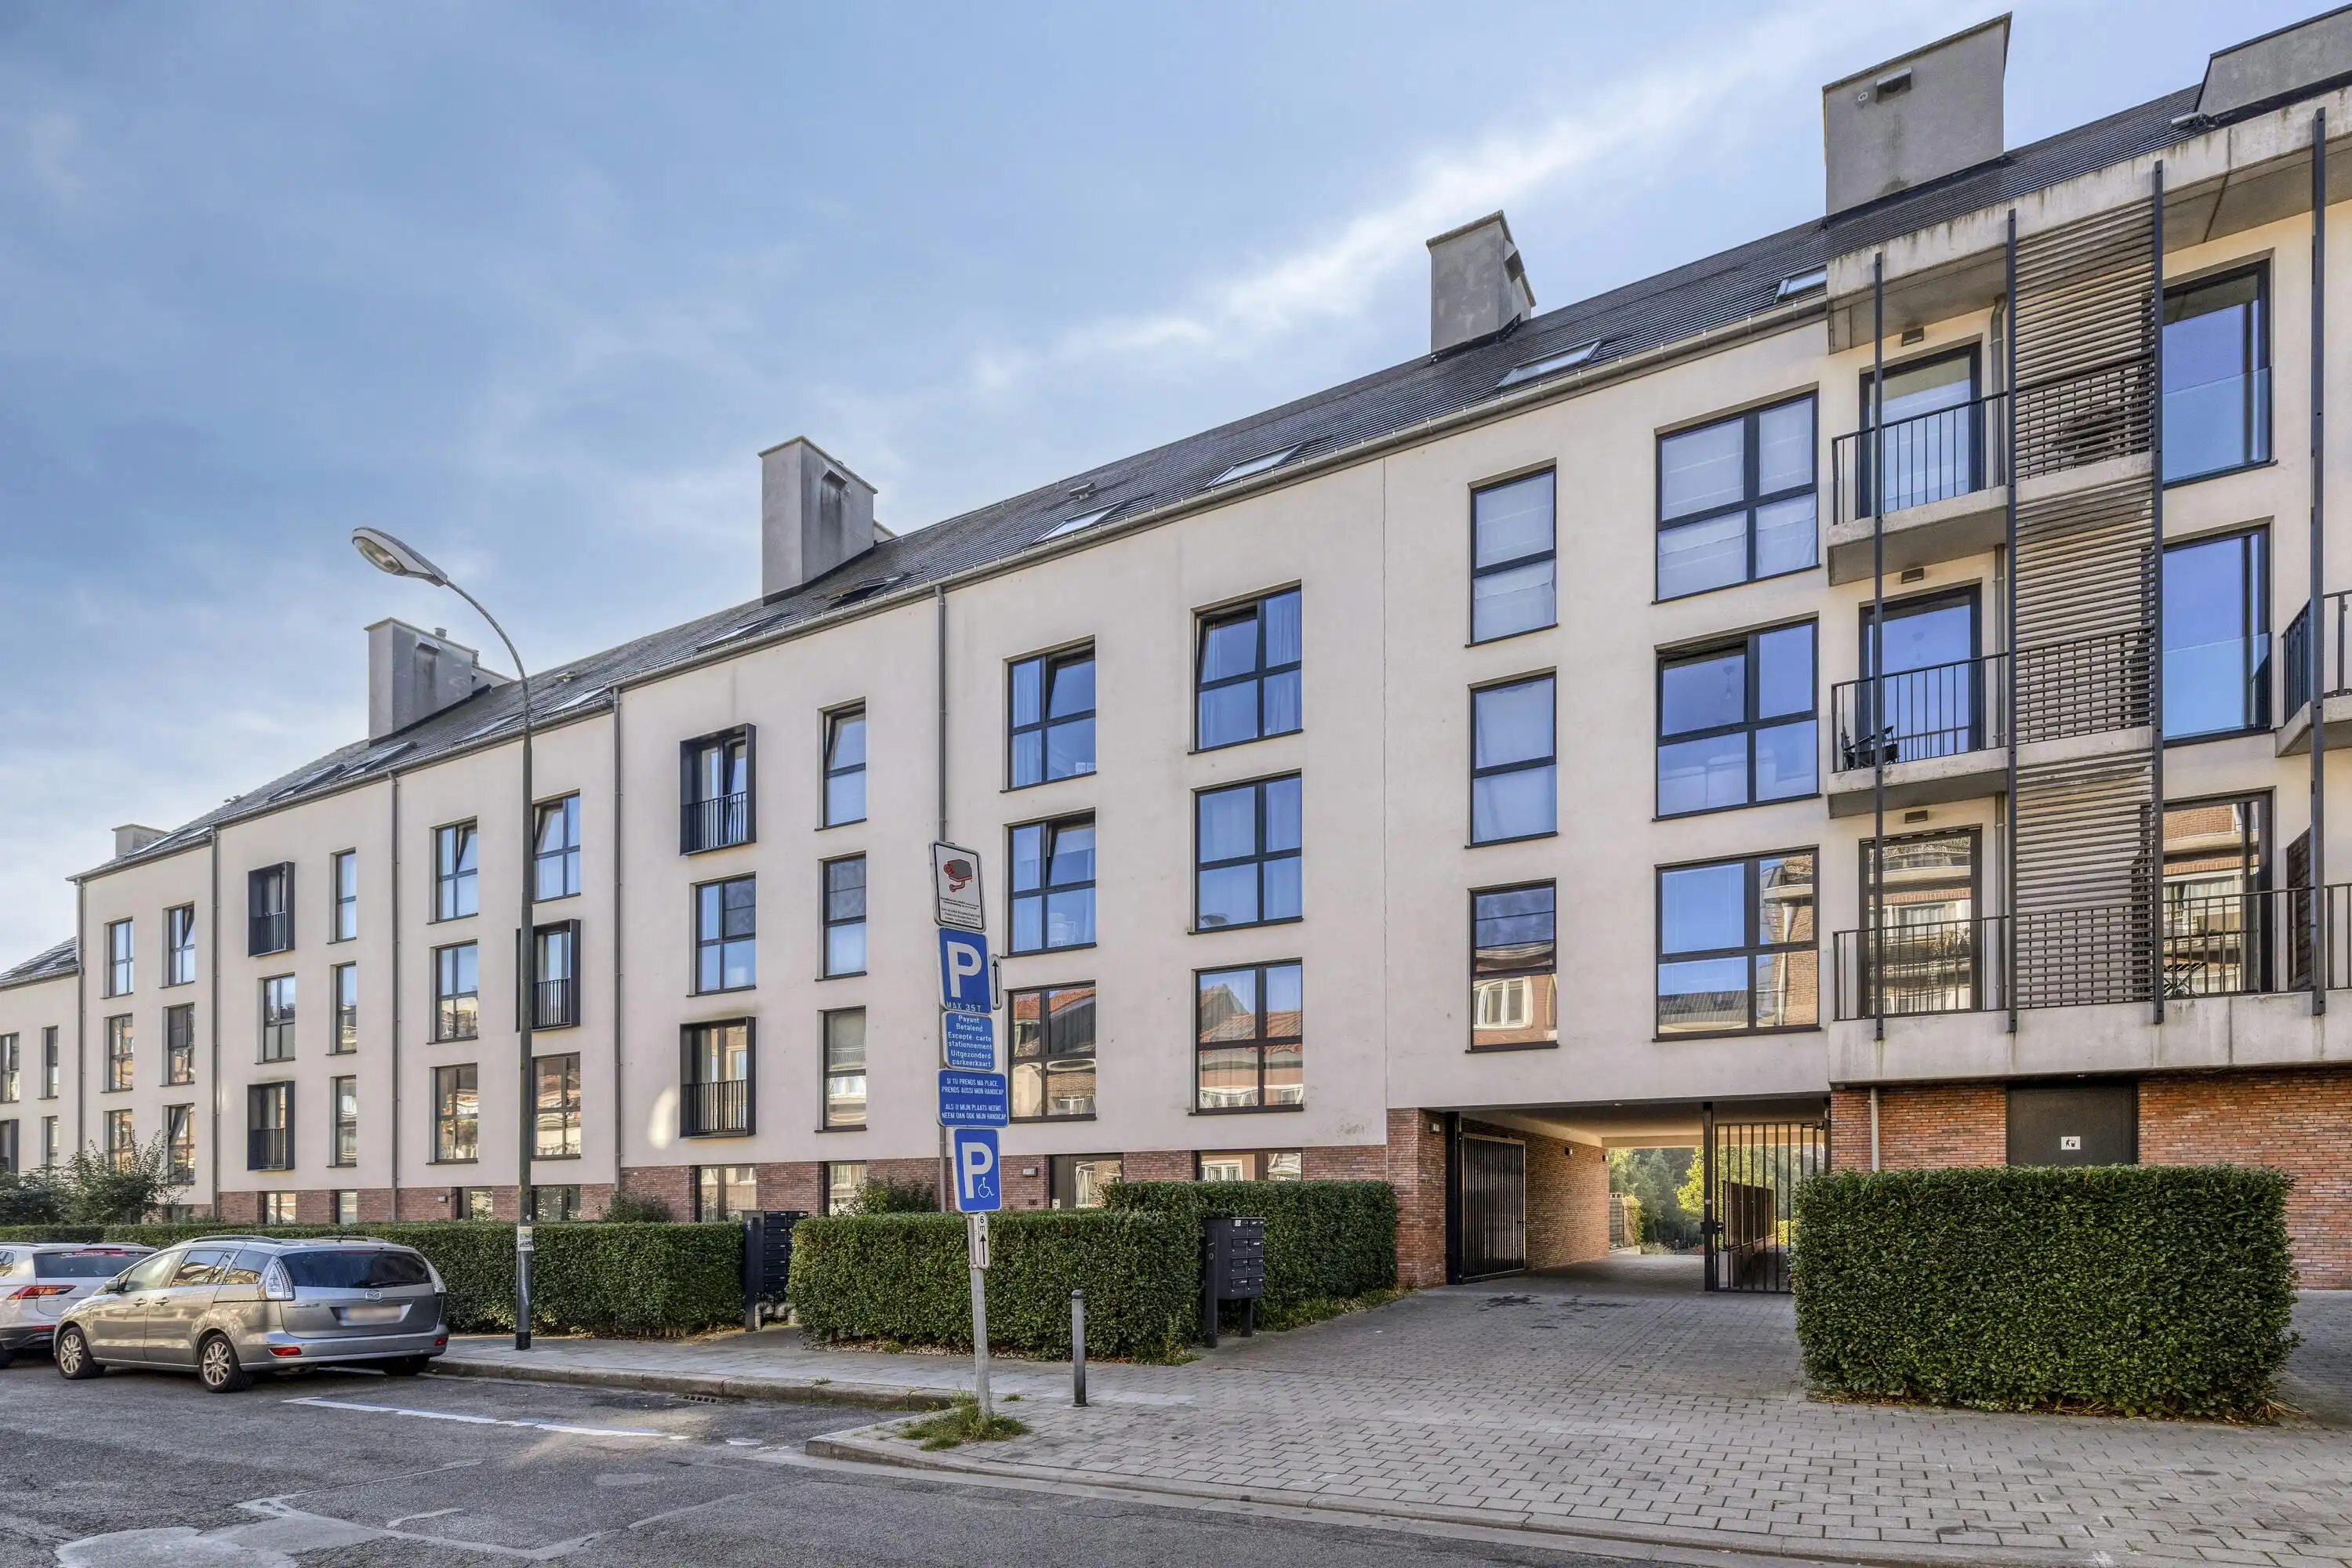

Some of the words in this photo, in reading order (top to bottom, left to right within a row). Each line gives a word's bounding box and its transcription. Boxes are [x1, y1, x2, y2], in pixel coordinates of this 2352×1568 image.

[947, 941, 982, 998] P
[946, 1001, 962, 1010] MAX
[958, 1015, 979, 1024] Payant
[956, 1023, 983, 1033] Betalend
[948, 1031, 973, 1040] Excepté
[948, 1041, 993, 1051] stationnement
[950, 1049, 992, 1059] Uitgezonderd
[952, 1058, 992, 1067] parkeerkaart
[961, 1142, 993, 1199] P
[980, 1215, 985, 1224] 6
